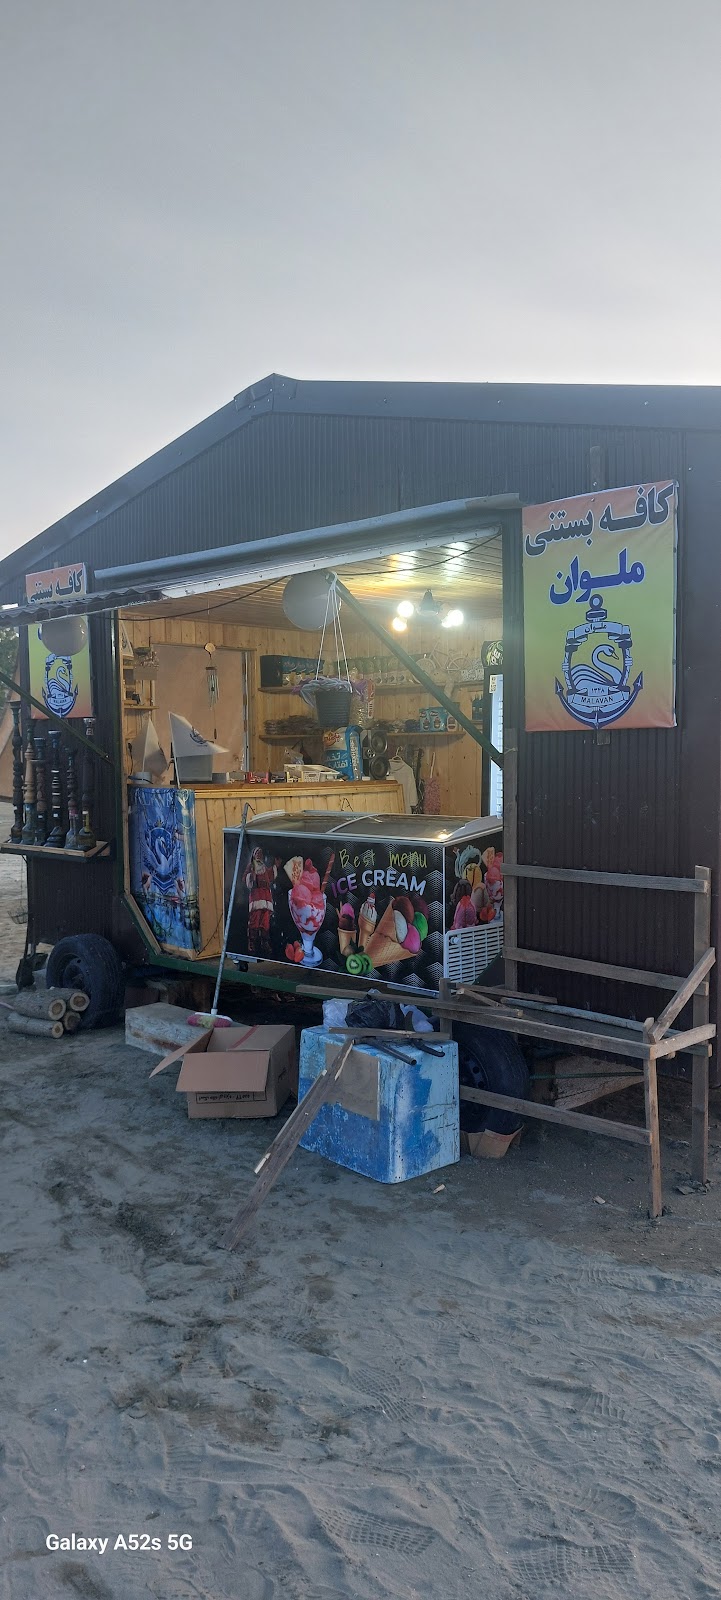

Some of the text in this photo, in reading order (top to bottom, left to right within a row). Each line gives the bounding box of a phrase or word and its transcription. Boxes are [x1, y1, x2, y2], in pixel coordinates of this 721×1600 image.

[525, 483, 675, 556] کافه بستنی
[55, 569, 83, 596] کافه
[549, 548, 645, 605] ملوان
[584, 622, 607, 633] ملوان
[580, 696, 614, 704] MALAVAN
[338, 848, 428, 869] Best menu
[331, 869, 427, 899] ICE CREAM
